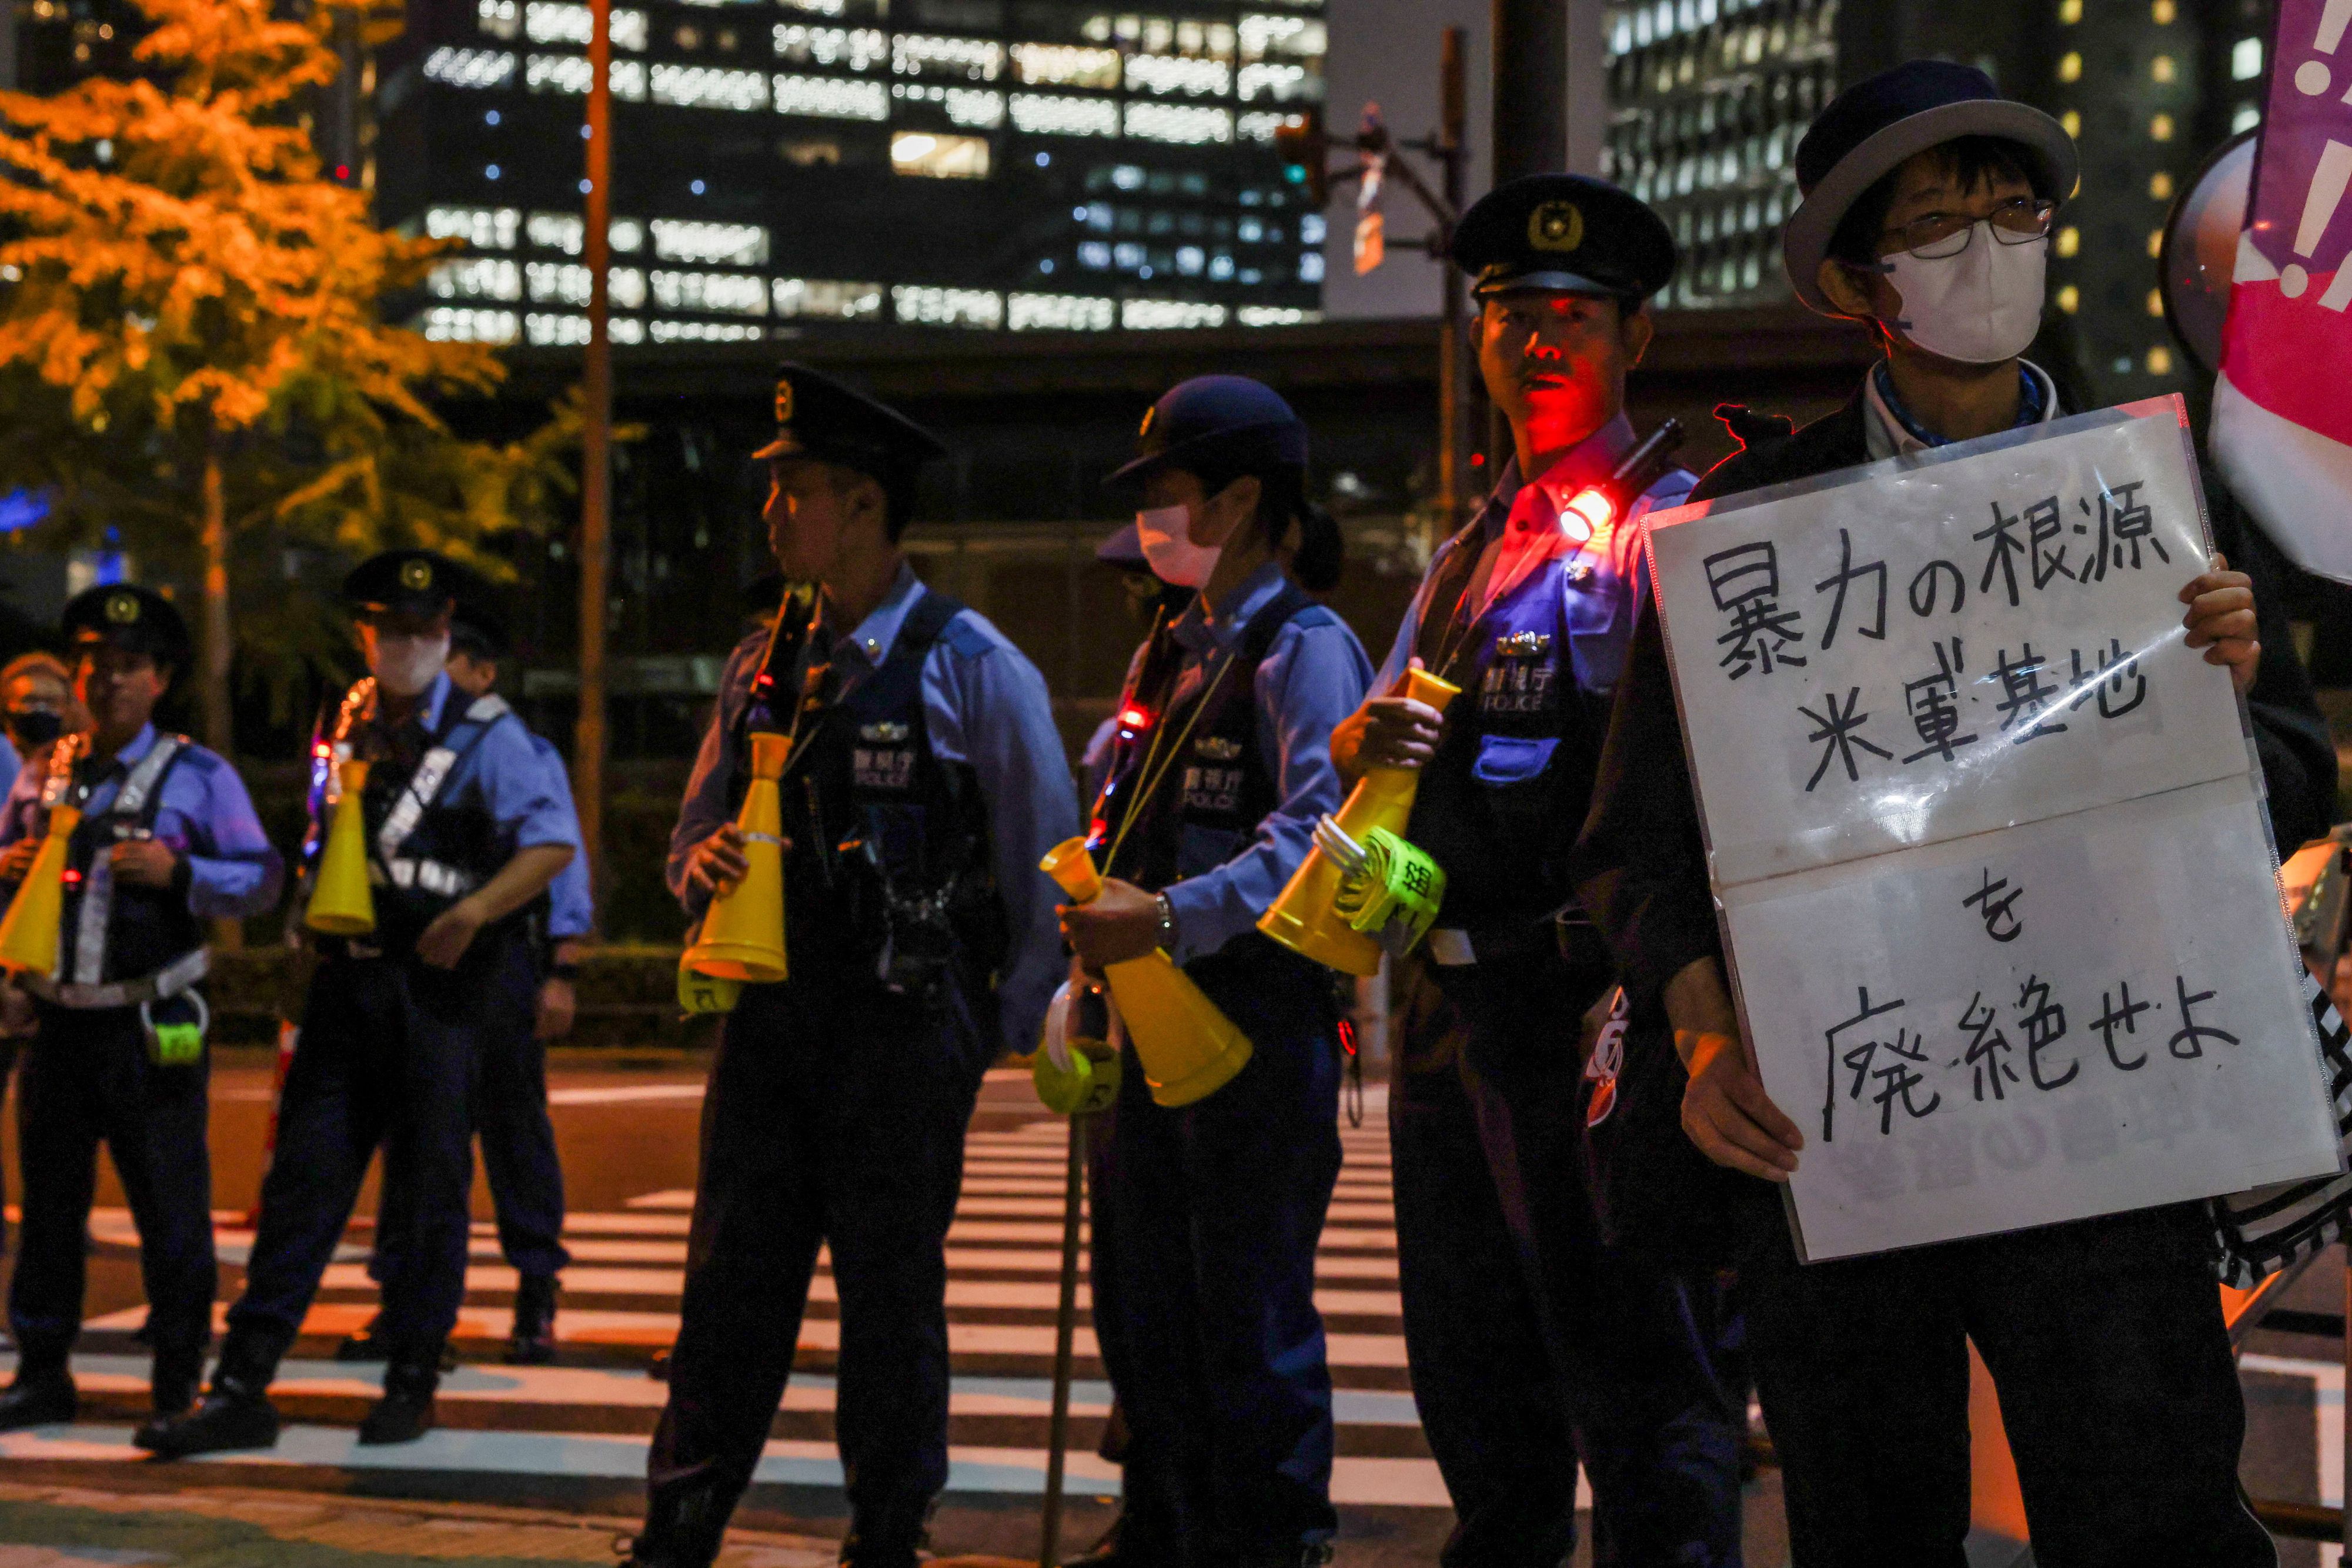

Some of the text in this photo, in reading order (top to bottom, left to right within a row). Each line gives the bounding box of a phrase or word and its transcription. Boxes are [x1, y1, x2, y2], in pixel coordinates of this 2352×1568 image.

[1703, 480, 2170, 680] 暴力の根源
[1483, 694, 1544, 712] POLICE
[1798, 636, 2146, 791] 米軍基地
[1962, 867, 2023, 942] を
[1822, 974, 2240, 1142] 廃絶せよ
